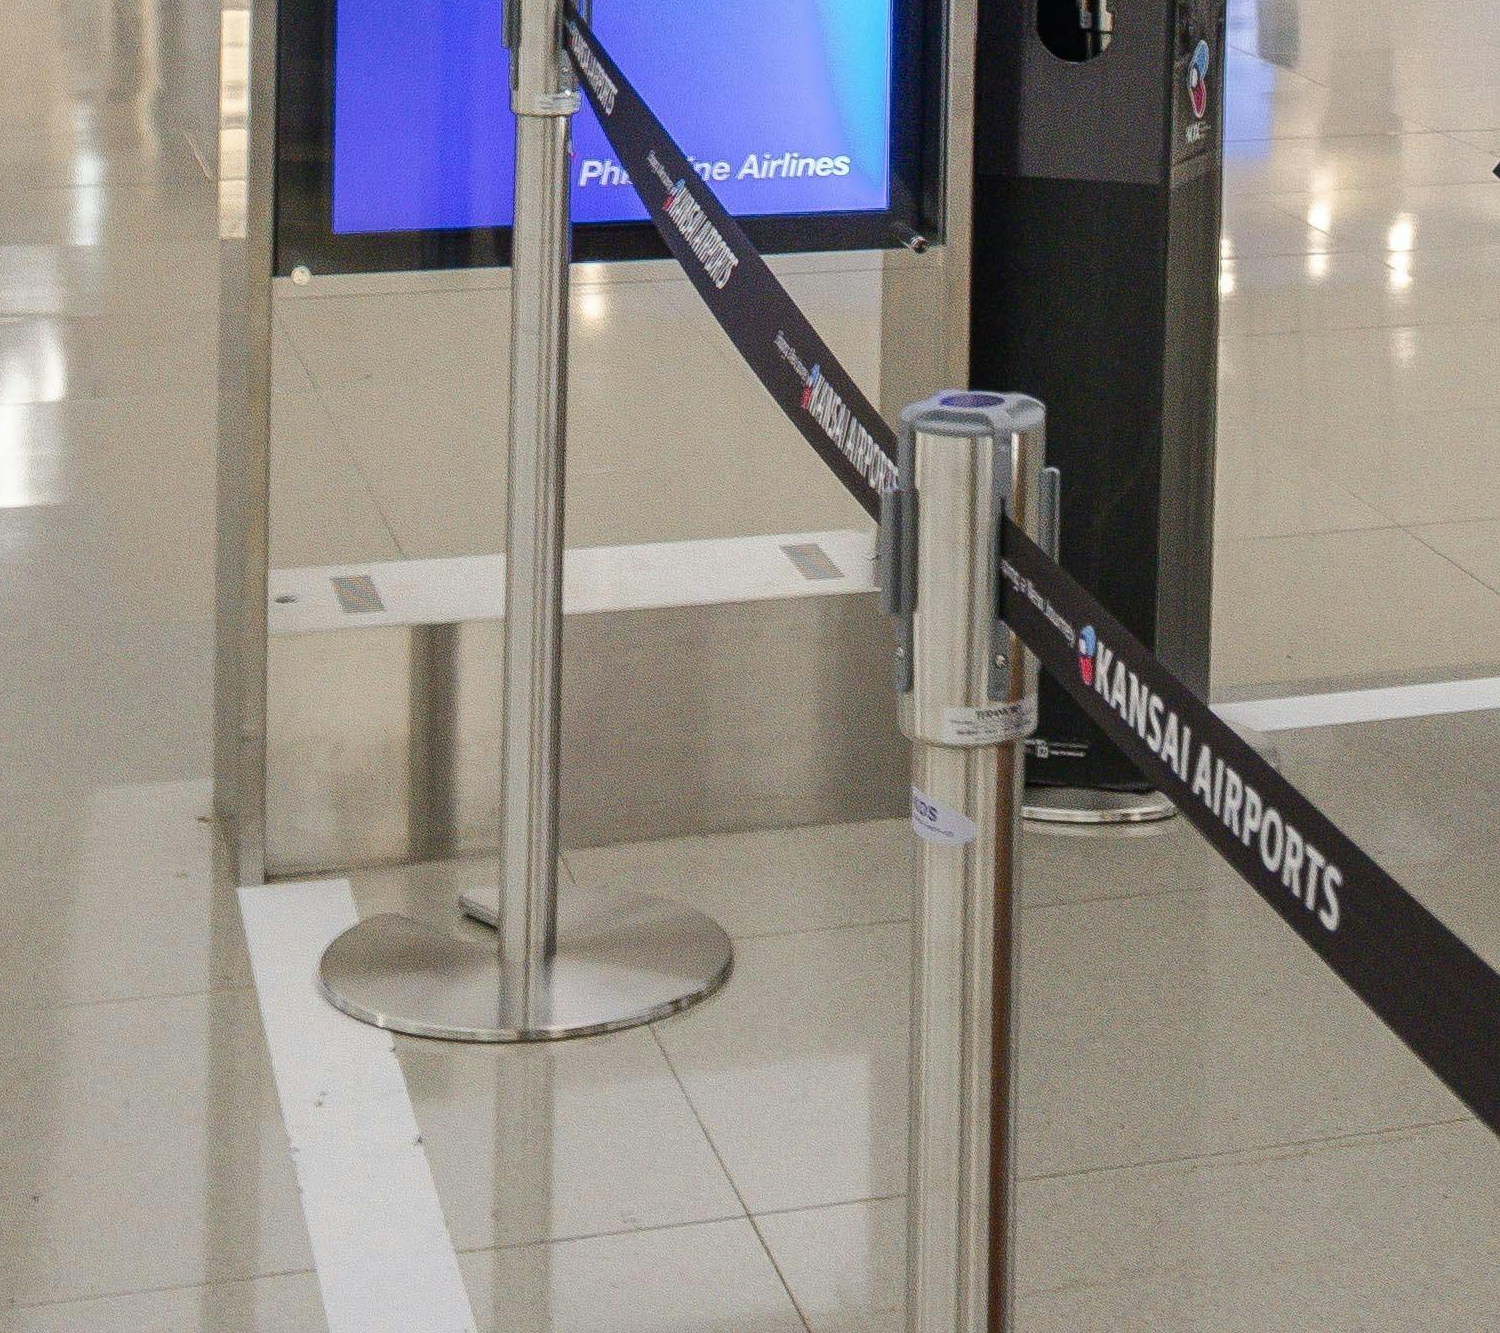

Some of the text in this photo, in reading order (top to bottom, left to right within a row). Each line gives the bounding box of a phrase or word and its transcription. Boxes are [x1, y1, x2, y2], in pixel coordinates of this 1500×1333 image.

[737, 152, 852, 181] Airlines
[1095, 641, 1192, 783] KANSAI
[1192, 744, 1344, 932] AIRPORTS
